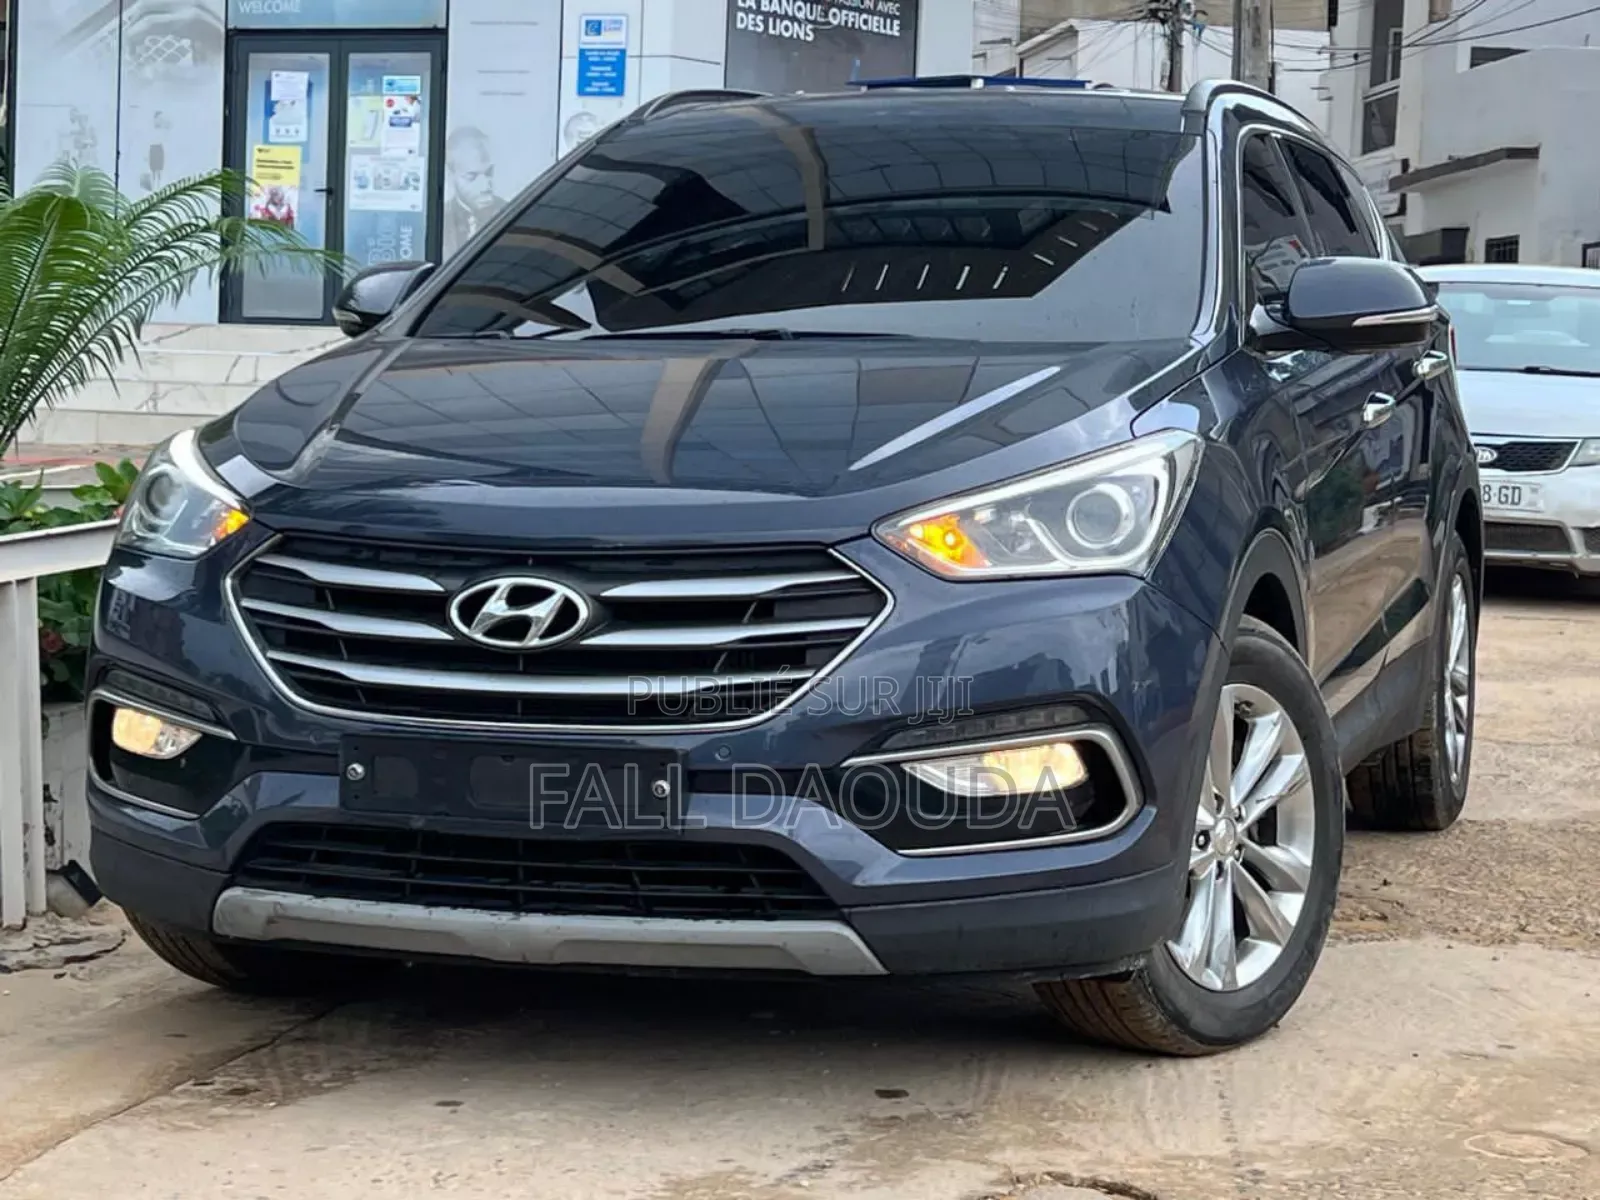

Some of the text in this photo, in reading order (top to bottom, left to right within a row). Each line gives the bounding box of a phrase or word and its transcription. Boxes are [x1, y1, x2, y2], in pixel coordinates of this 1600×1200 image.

[736, 11, 815, 42] DES LIONS
[828, 7, 901, 37] OFFICIELLE
